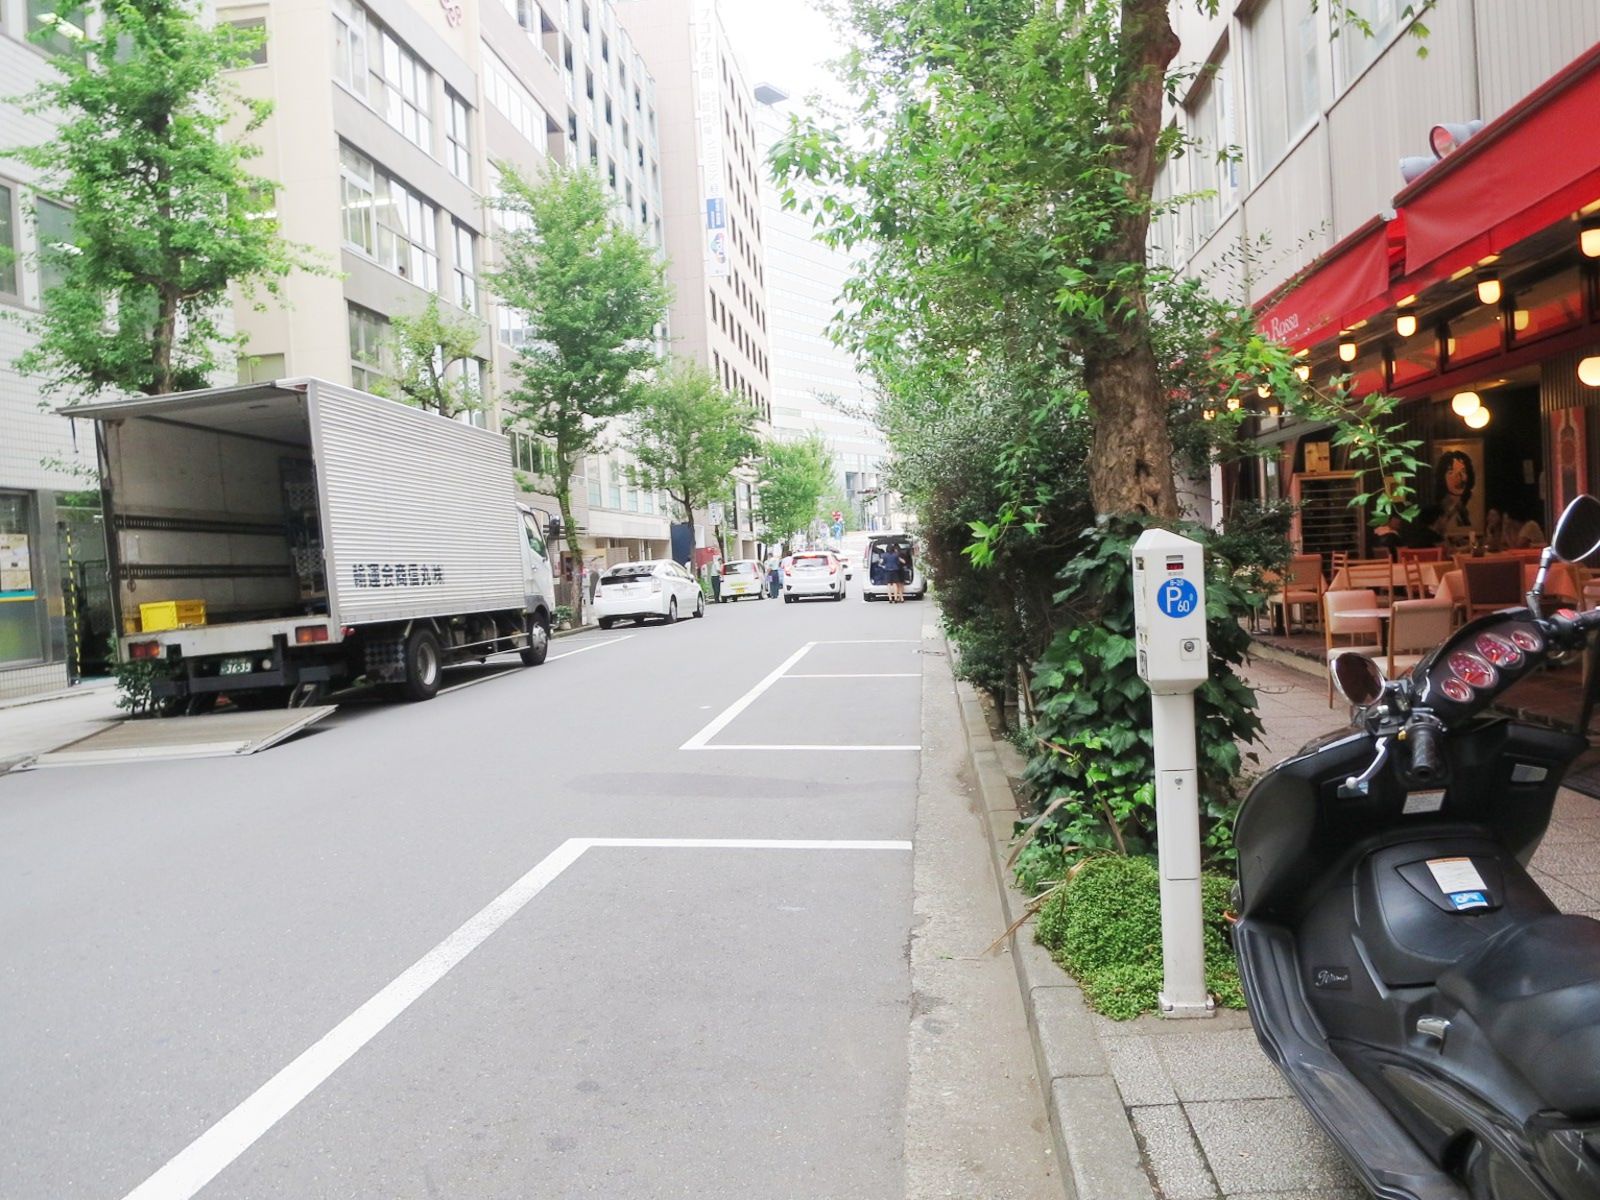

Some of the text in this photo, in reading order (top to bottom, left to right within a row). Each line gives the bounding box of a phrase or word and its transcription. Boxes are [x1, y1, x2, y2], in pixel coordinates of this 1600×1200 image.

[697, 8, 714, 80] フコク生命
[1166, 586, 1182, 613] P
[1177, 600, 1190, 613] 60
